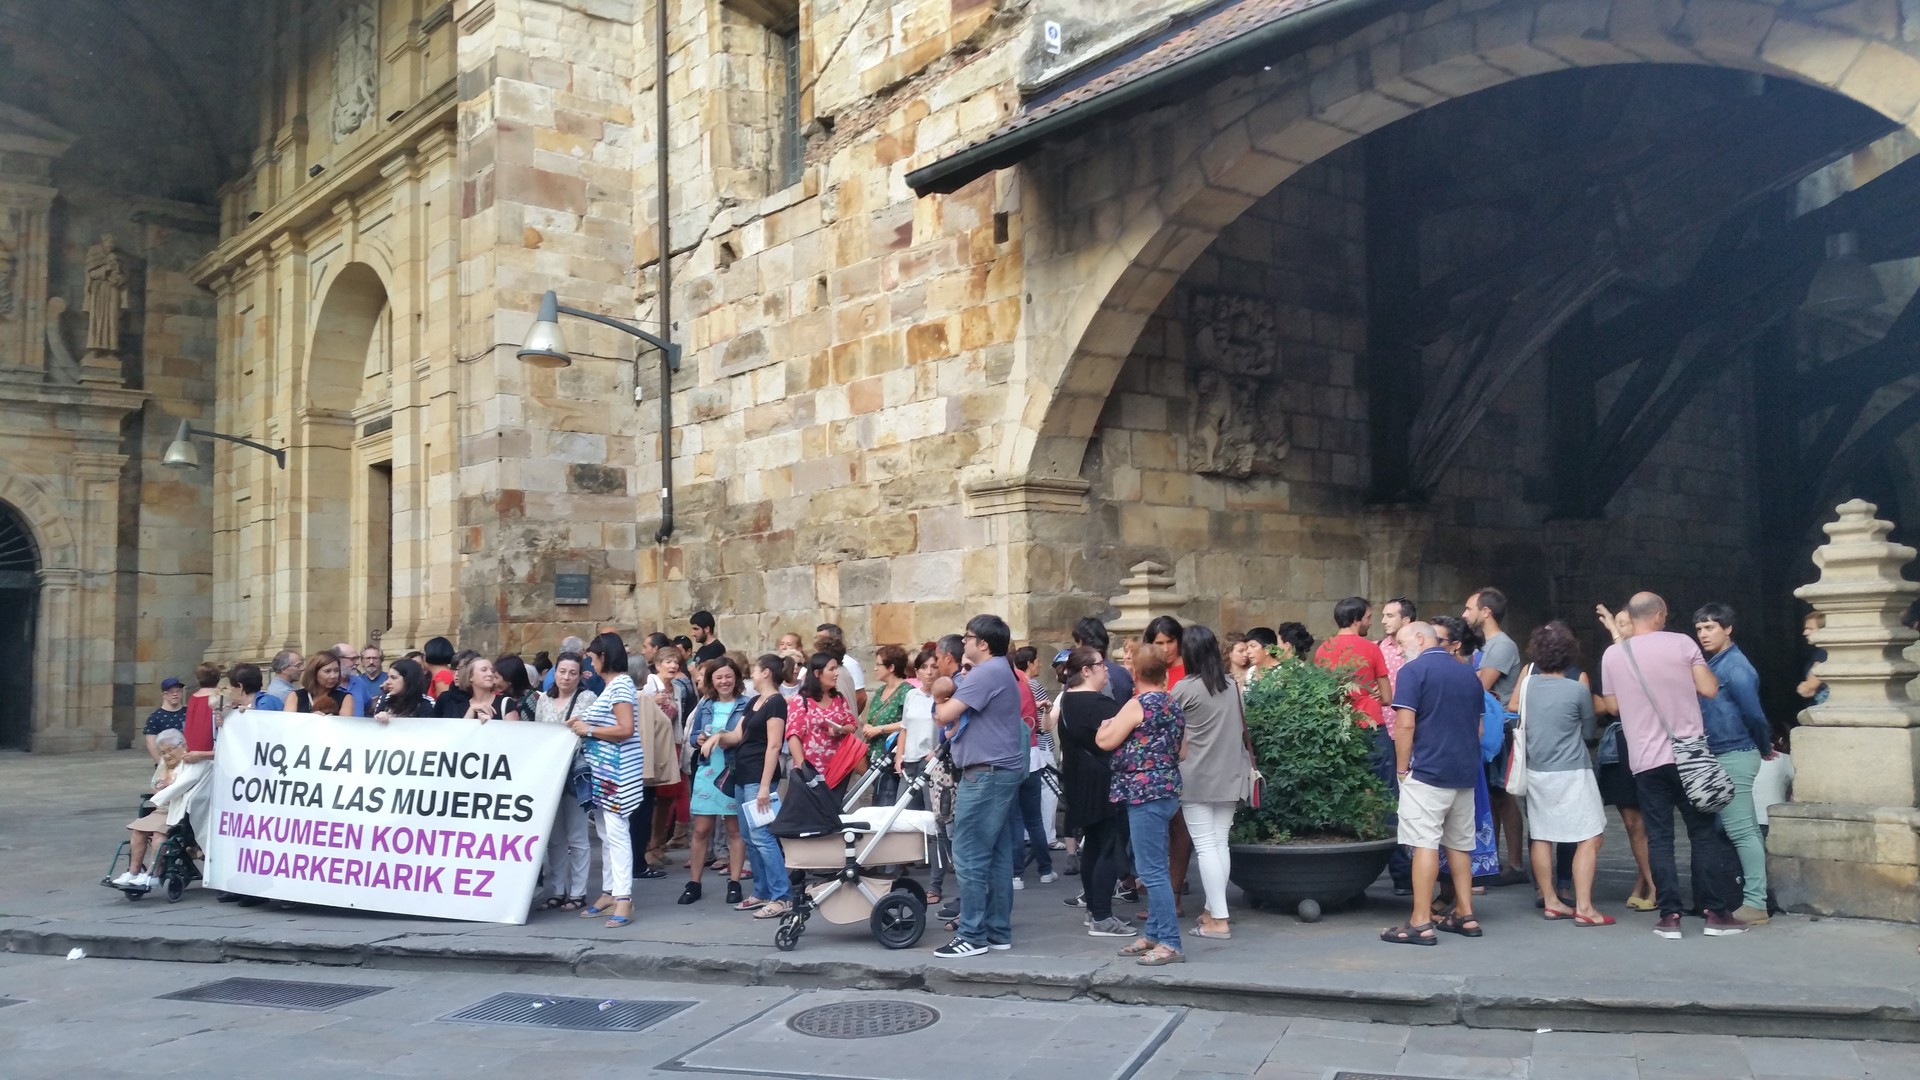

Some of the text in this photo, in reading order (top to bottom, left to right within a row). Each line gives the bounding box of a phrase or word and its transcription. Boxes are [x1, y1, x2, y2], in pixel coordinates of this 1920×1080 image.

[254, 741, 512, 781] NO A LA VIOLENCIA
[232, 776, 534, 823] CONTRA LAS MUJERES
[218, 811, 364, 850] EMAKUMEEN
[237, 847, 495, 898] INDARKERIARIK EZ
